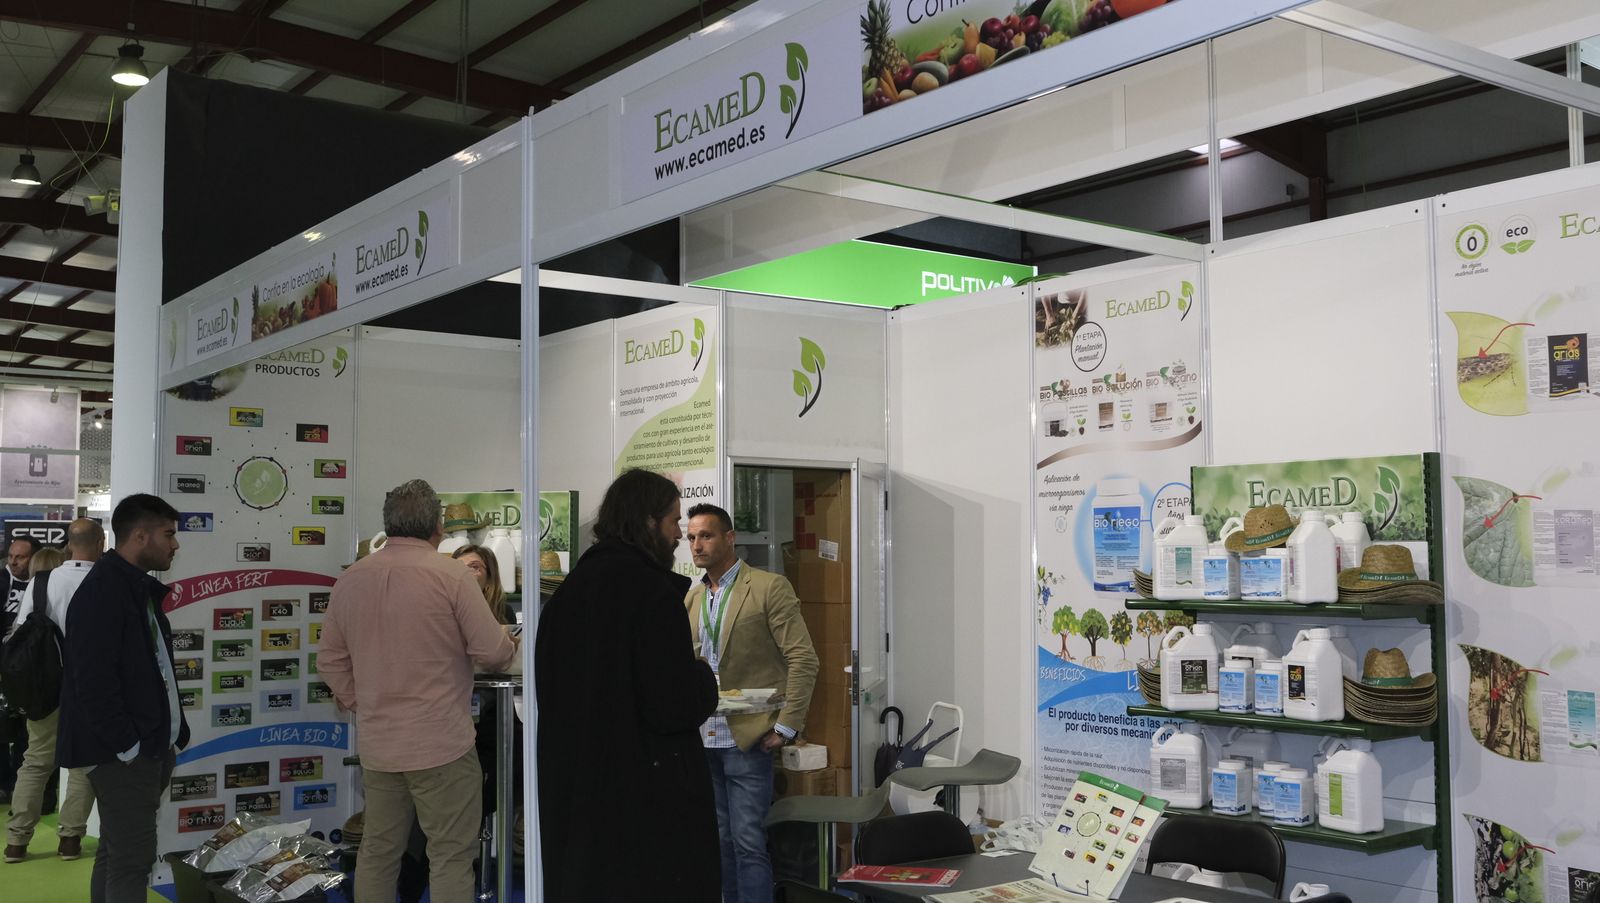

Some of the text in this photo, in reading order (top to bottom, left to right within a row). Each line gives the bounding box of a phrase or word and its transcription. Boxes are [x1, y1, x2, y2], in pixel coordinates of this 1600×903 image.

[654, 71, 766, 153] ECAMED
[654, 125, 766, 181] www.ecamed.es
[1506, 226, 1528, 238] eco
[355, 227, 409, 274] ECAMED
[281, 280, 290, 294] en
[290, 276, 297, 292] la
[297, 262, 325, 289] ecología
[355, 264, 409, 294] www.ecamed.es
[1105, 290, 1171, 319] ECAMED
[1082, 330, 1102, 341] ETAPA
[624, 329, 684, 365] ECAMED
[1553, 348, 1580, 359] arias
[255, 363, 320, 379] PRODUCTOS
[1040, 391, 1051, 399] BIO
[1074, 473, 1080, 482] de
[680, 485, 714, 499] LIZACIÓN
[1247, 476, 1357, 509] ECAMED
[12, 528, 65, 543] SER
[191, 570, 273, 599] LINEA FERT
[1040, 666, 1087, 682] BENEFICIOS
[1048, 707, 1057, 718] El
[1058, 709, 1097, 722] producto
[1098, 711, 1138, 727] beneficia
[1139, 719, 1145, 727] a
[1147, 717, 1161, 728] las
[259, 727, 327, 743] LINEA BIO
[1065, 722, 1079, 733] por
[1081, 722, 1119, 736] diversos
